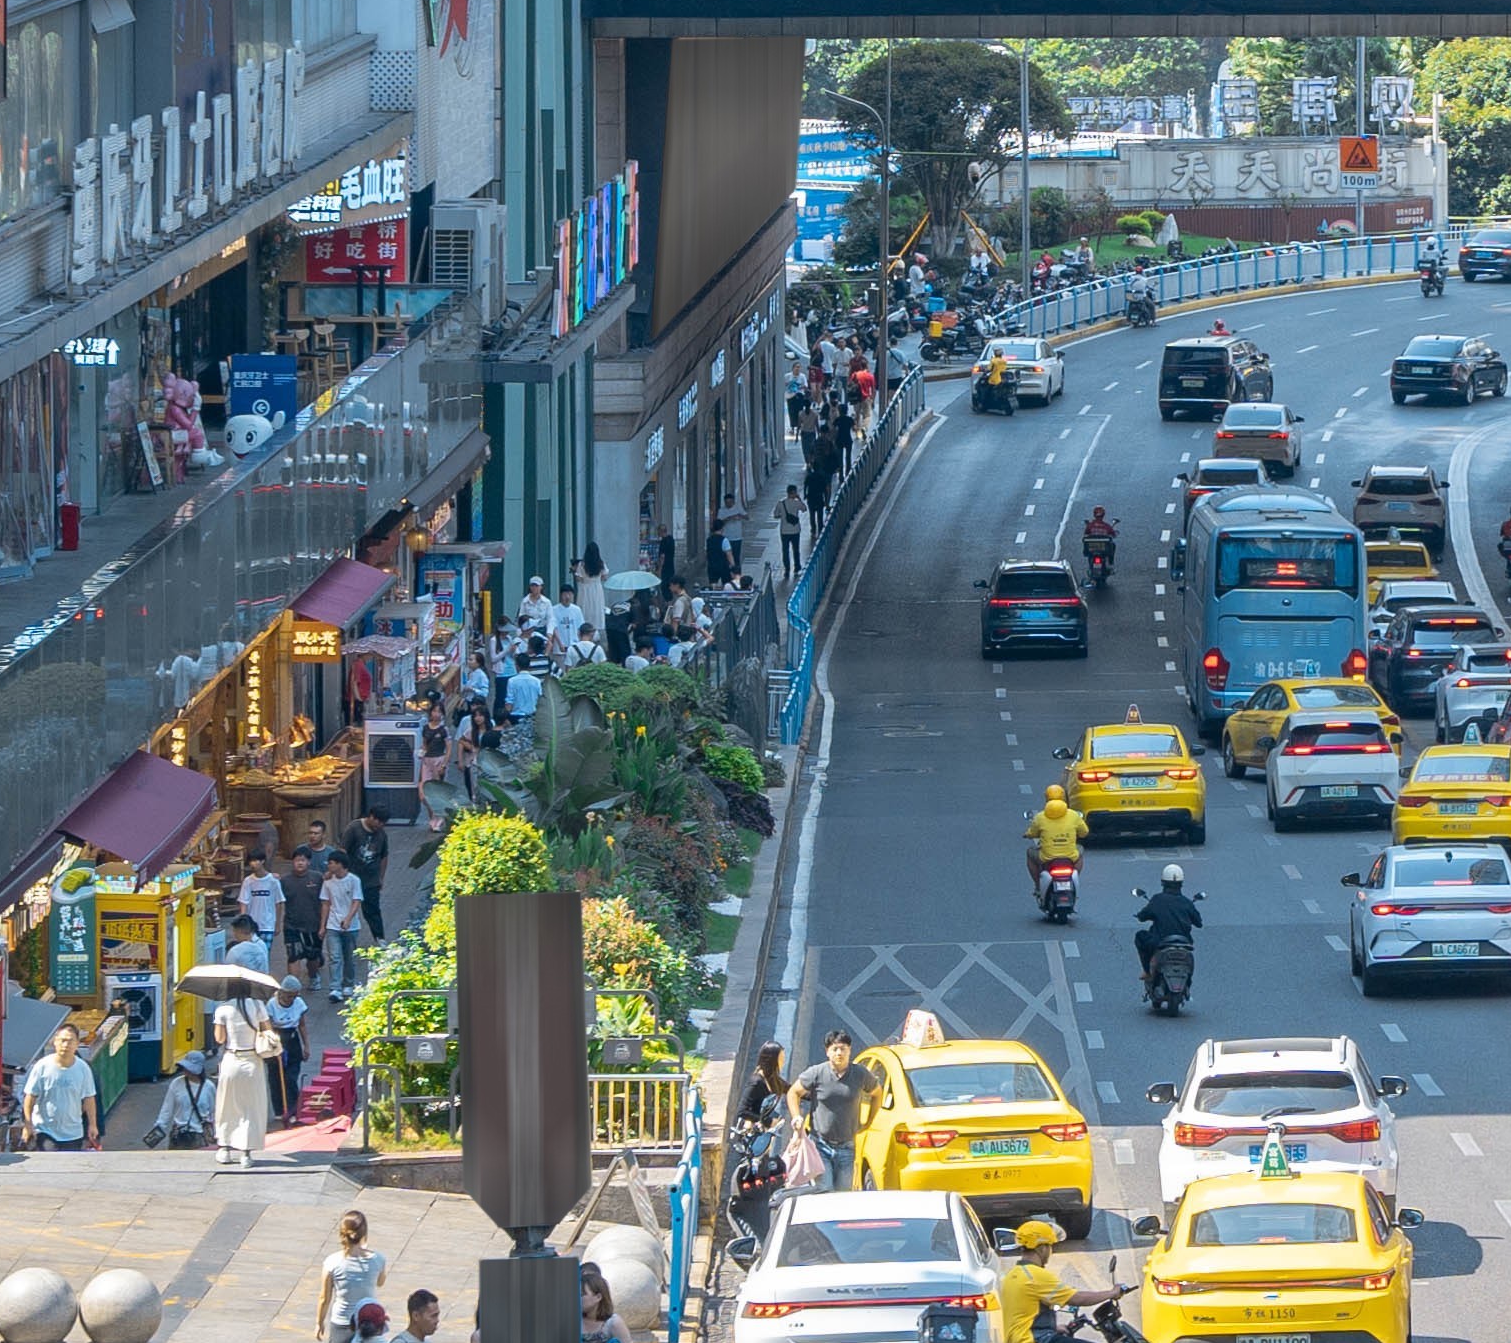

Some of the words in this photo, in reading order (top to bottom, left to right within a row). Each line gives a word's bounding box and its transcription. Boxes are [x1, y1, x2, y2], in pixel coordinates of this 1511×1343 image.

[340, 158, 407, 210] 毛血旺
[1342, 175, 1376, 187] 100m
[314, 241, 399, 261] 好吃街
